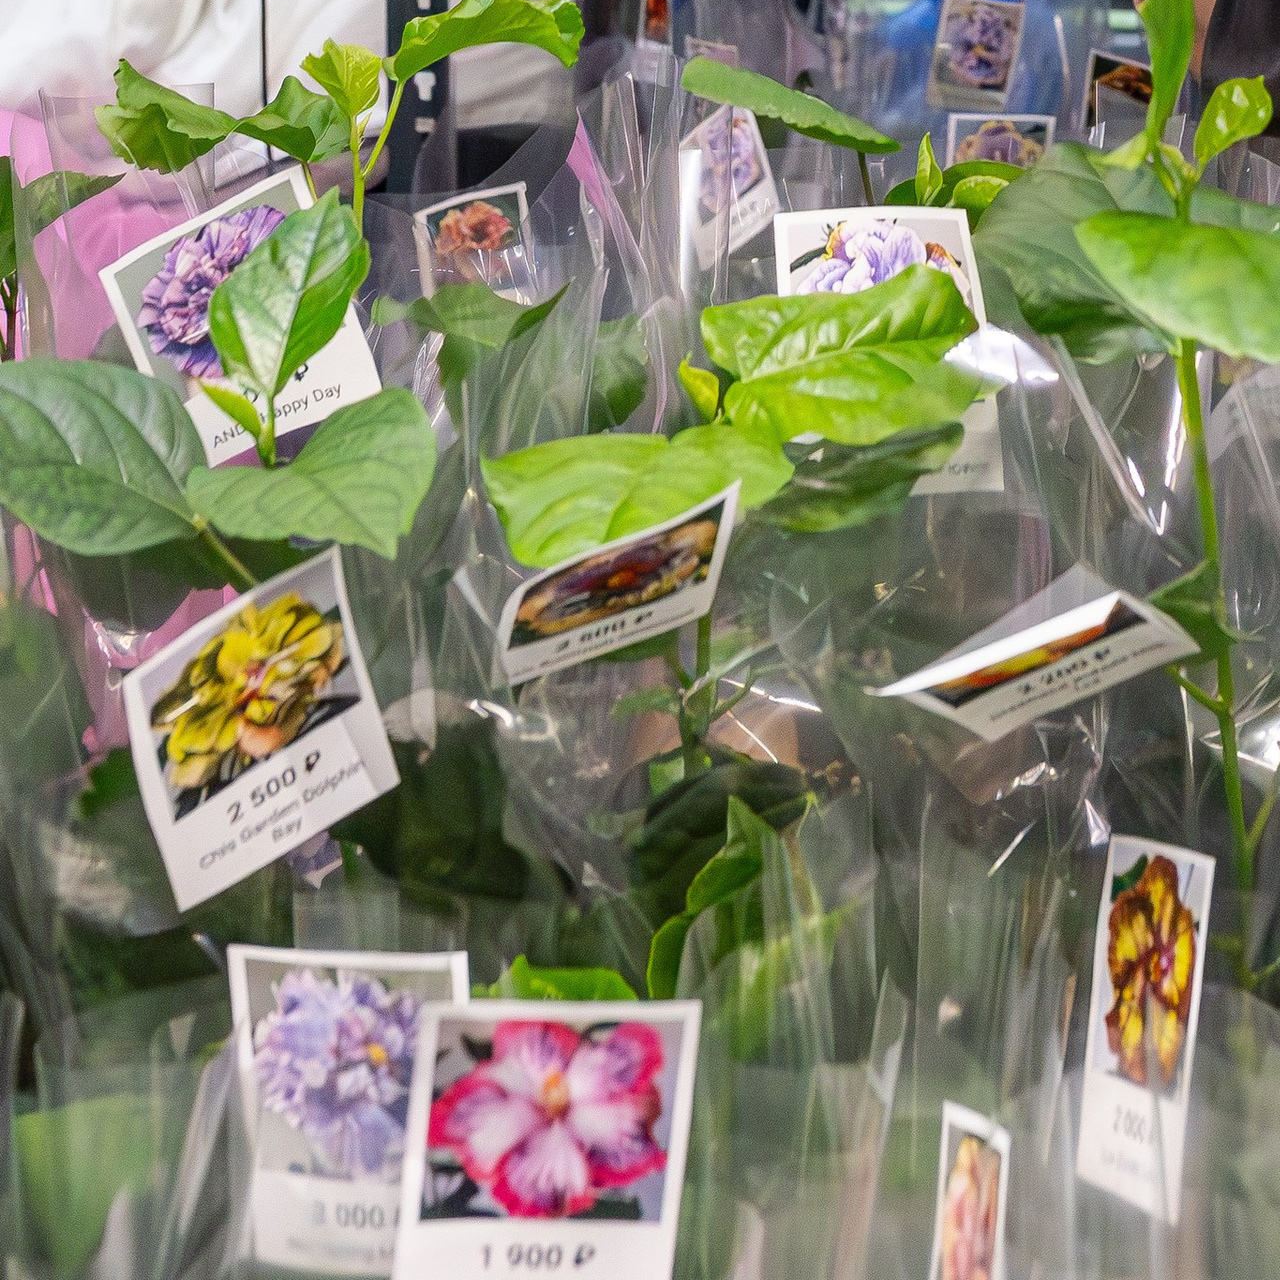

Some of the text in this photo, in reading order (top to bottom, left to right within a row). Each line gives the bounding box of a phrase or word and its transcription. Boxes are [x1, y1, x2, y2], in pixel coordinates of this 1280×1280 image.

[312, 382, 343, 404] Day
[226, 800, 244, 826] 2
[249, 764, 298, 809] 500
[482, 1241, 492, 1271] 1
[506, 1242, 564, 1272] 900
